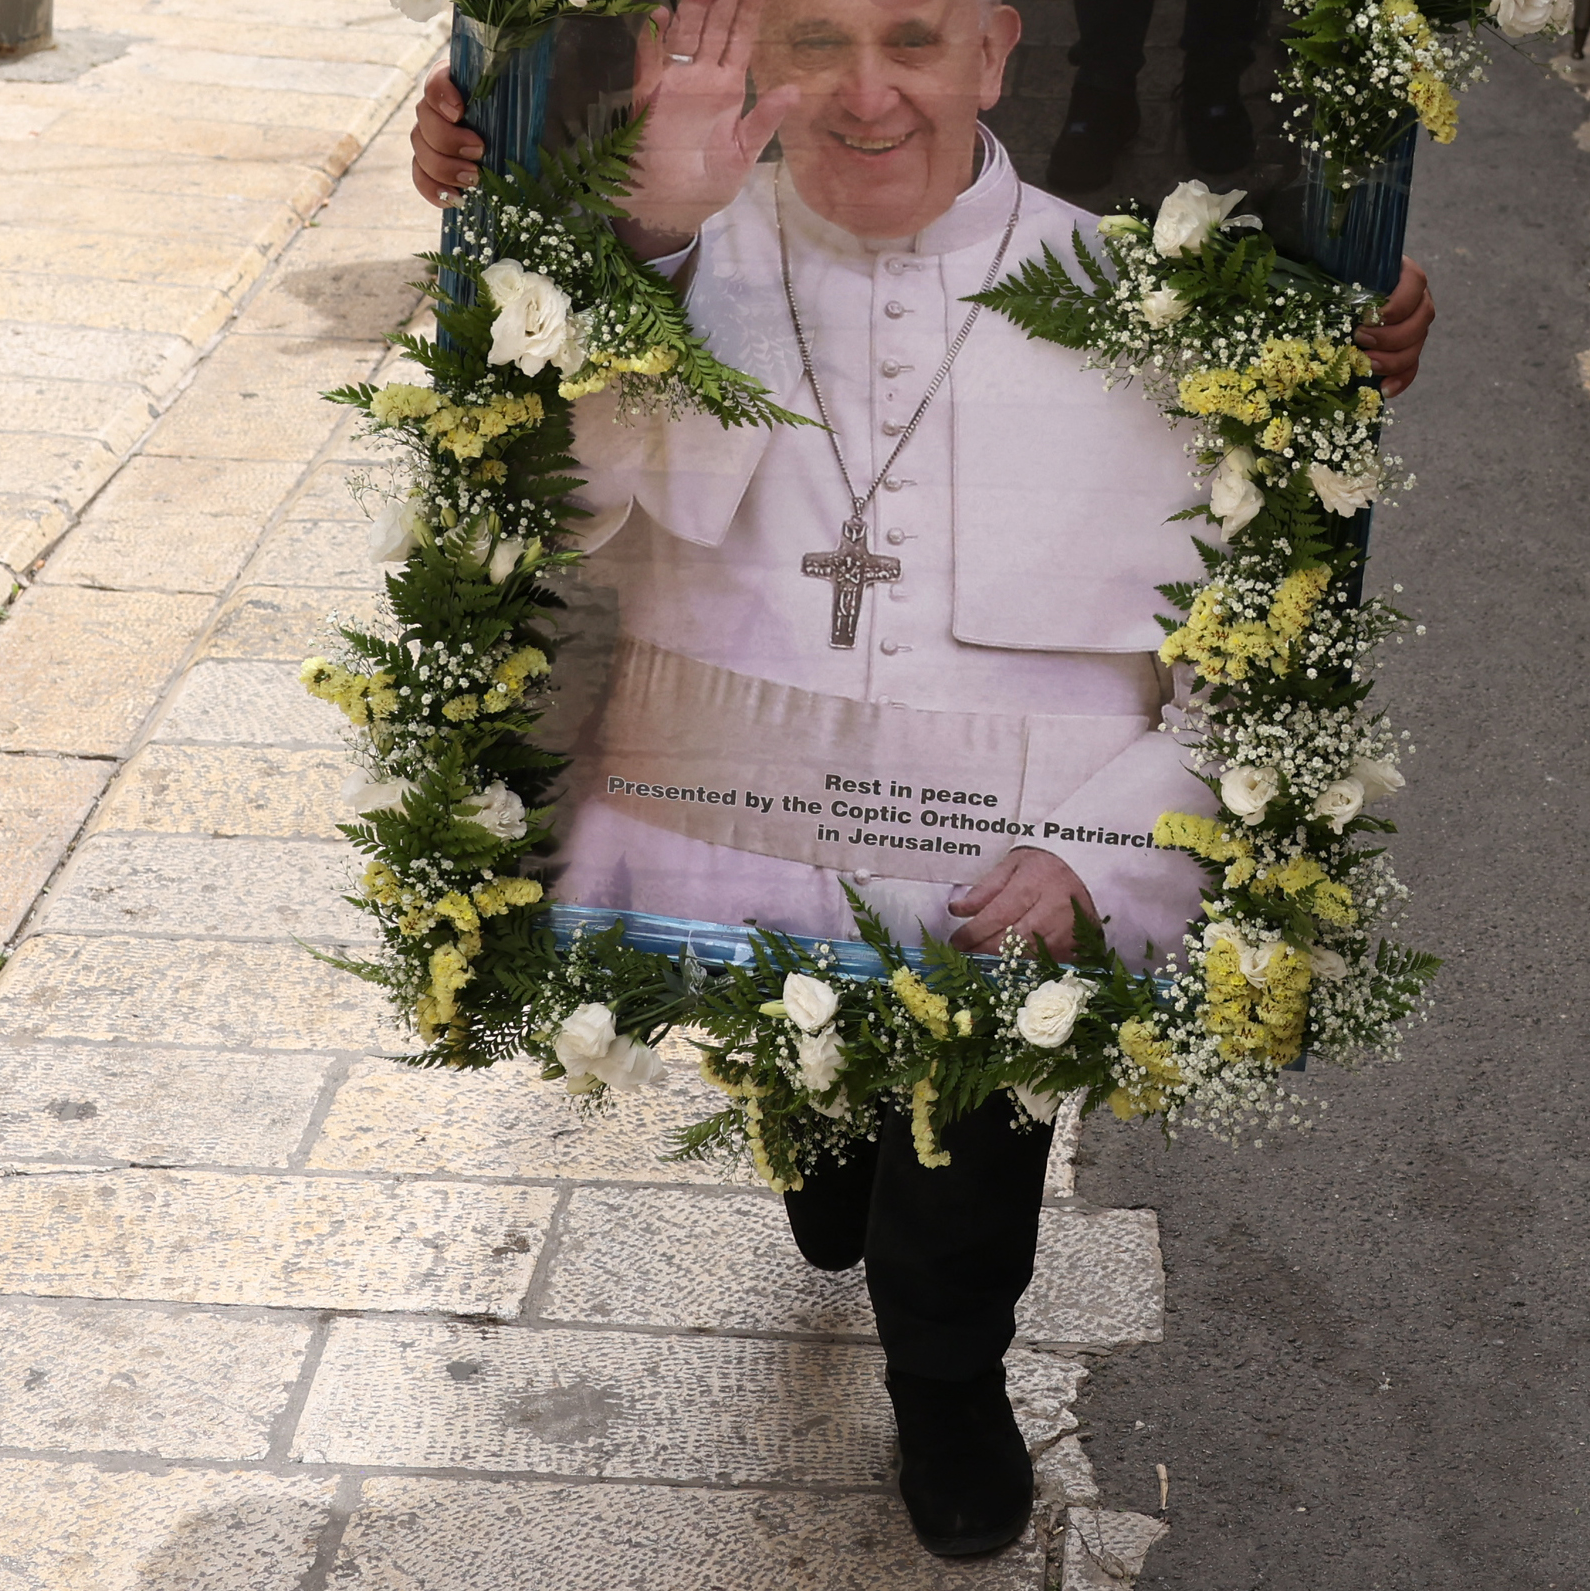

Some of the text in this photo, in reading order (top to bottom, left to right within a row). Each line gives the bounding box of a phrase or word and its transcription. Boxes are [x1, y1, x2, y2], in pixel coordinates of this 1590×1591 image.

[607, 776, 737, 806] Presented
[745, 791, 774, 813] by
[782, 795, 823, 815] the
[830, 800, 912, 825] Coptic
[920, 809, 1036, 837] Orthodox
[824, 773, 999, 808] Rest in peace
[816, 824, 982, 857] in Jerusalem
